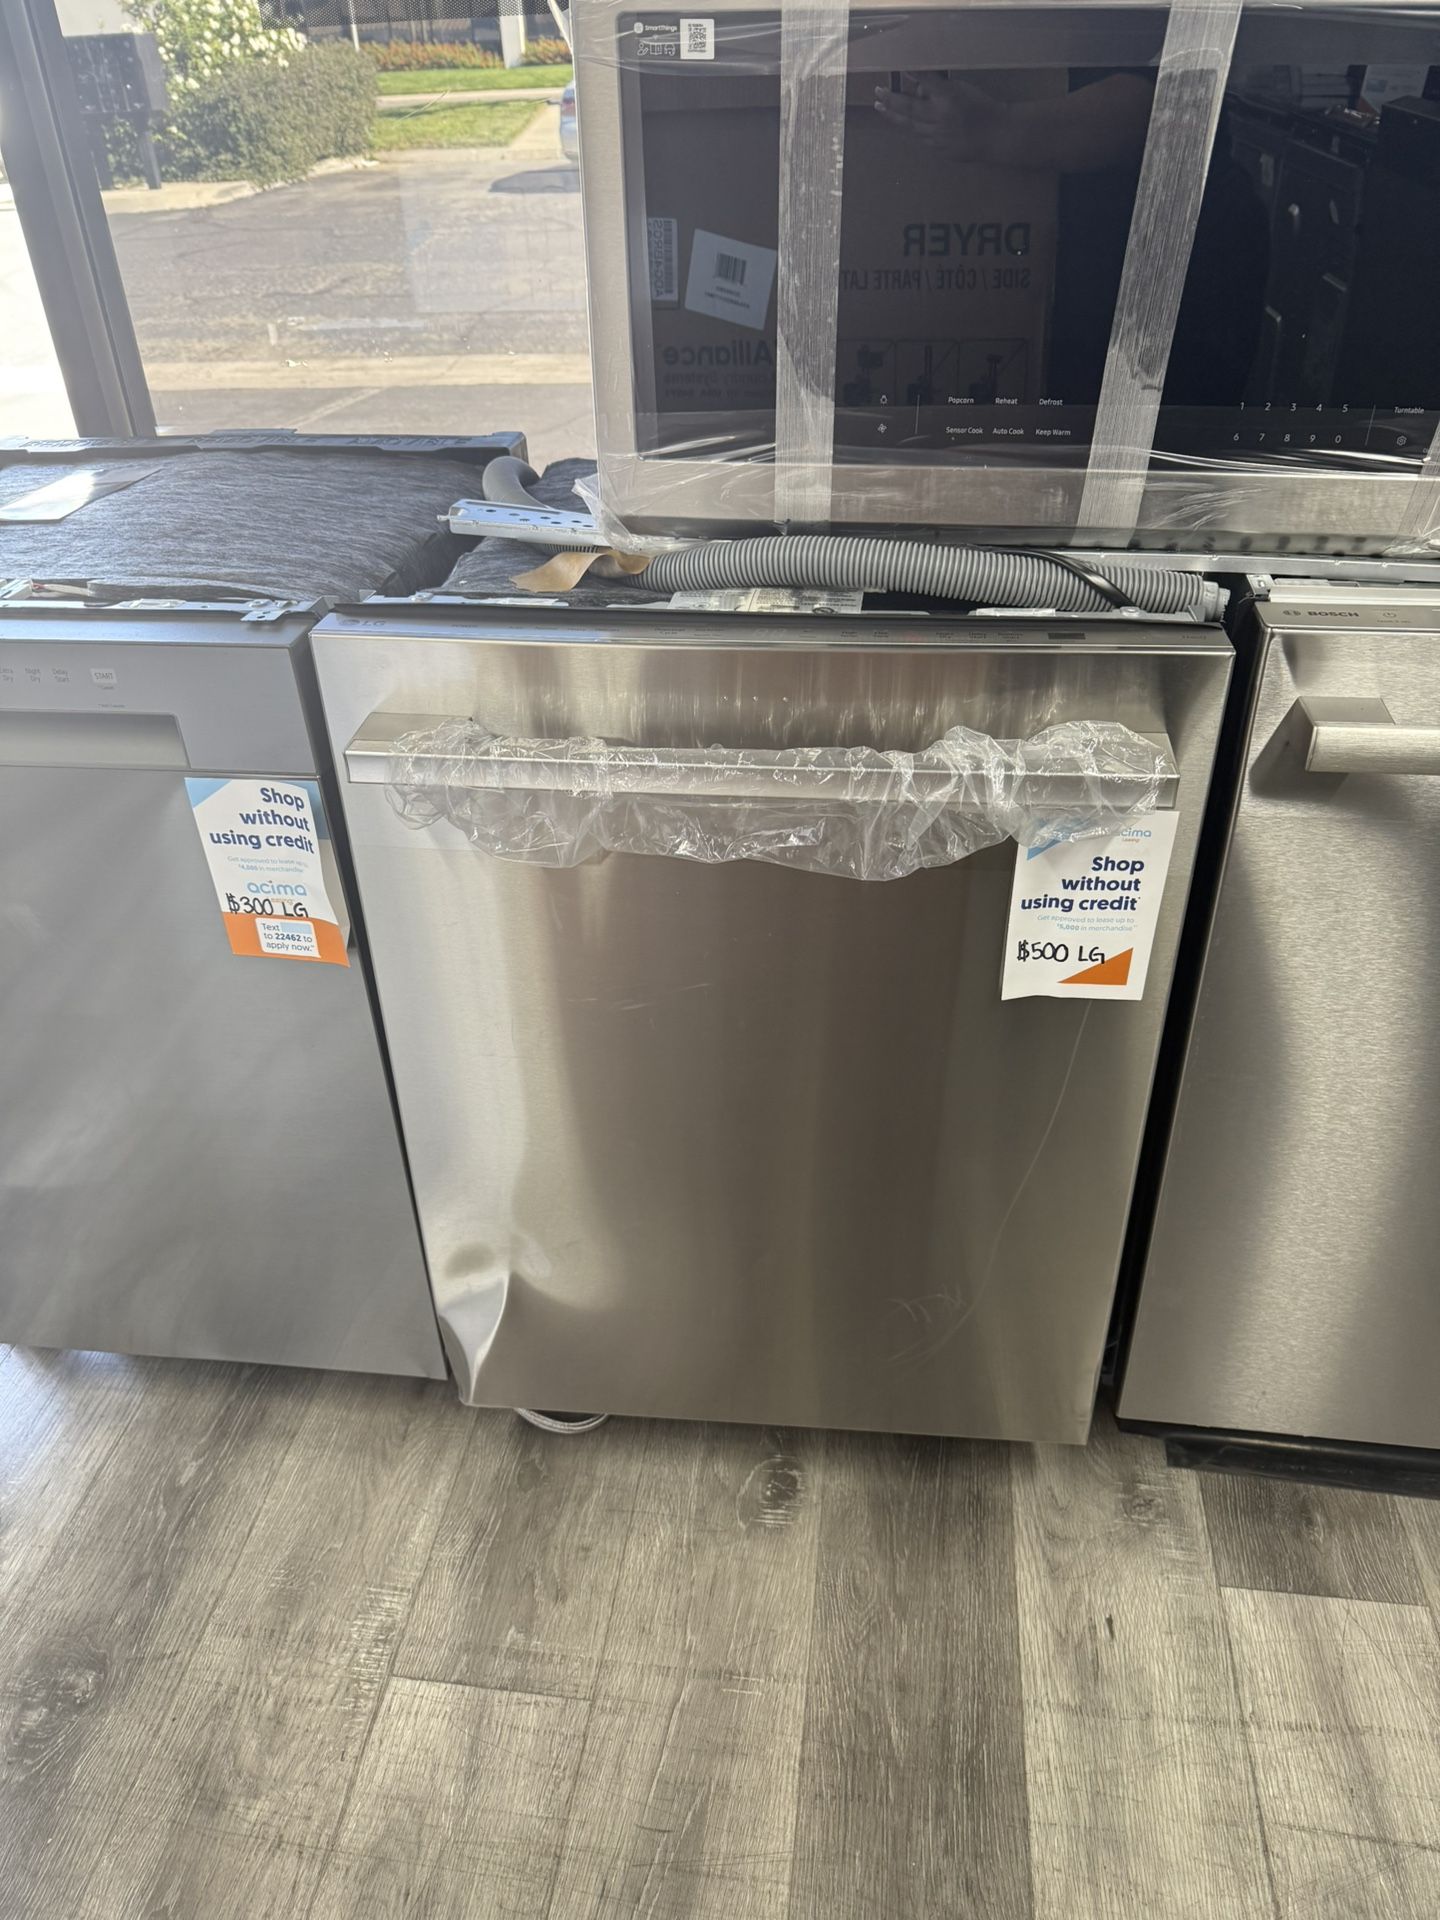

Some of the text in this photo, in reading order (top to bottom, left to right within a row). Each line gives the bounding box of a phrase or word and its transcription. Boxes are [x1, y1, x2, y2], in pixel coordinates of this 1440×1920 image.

[644, 24, 678, 33] SmartThings
[948, 396, 974, 405] Popcorn
[995, 397, 1018, 405] Reheat
[1039, 398, 1063, 406] Defrost
[1240, 402, 1348, 412] 1 2 3 4 5
[945, 426, 967, 434] Sensor
[992, 427, 1007, 435] Auto
[1035, 428, 1051, 437] Keep
[1233, 433, 1239, 441] 6
[1259, 433, 1265, 441] 7
[1284, 434, 1290, 442] 8
[1310, 434, 1315, 443] 9
[94, 672, 113, 680] START
[260, 787, 305, 811] Shop
[239, 809, 311, 832] without
[209, 830, 315, 854] using credit
[1091, 856, 1145, 875] Shop
[247, 880, 307, 896] acima
[1061, 876, 1141, 892] without
[225, 892, 310, 918] $300 LG
[1020, 894, 1074, 913] using
[1051, 915, 1086, 923] approved
[262, 922, 280, 931] Text
[275, 932, 302, 942] 22462
[303, 935, 313, 943] to
[266, 942, 290, 951] apply
[1017, 939, 1106, 964] $500 LG
